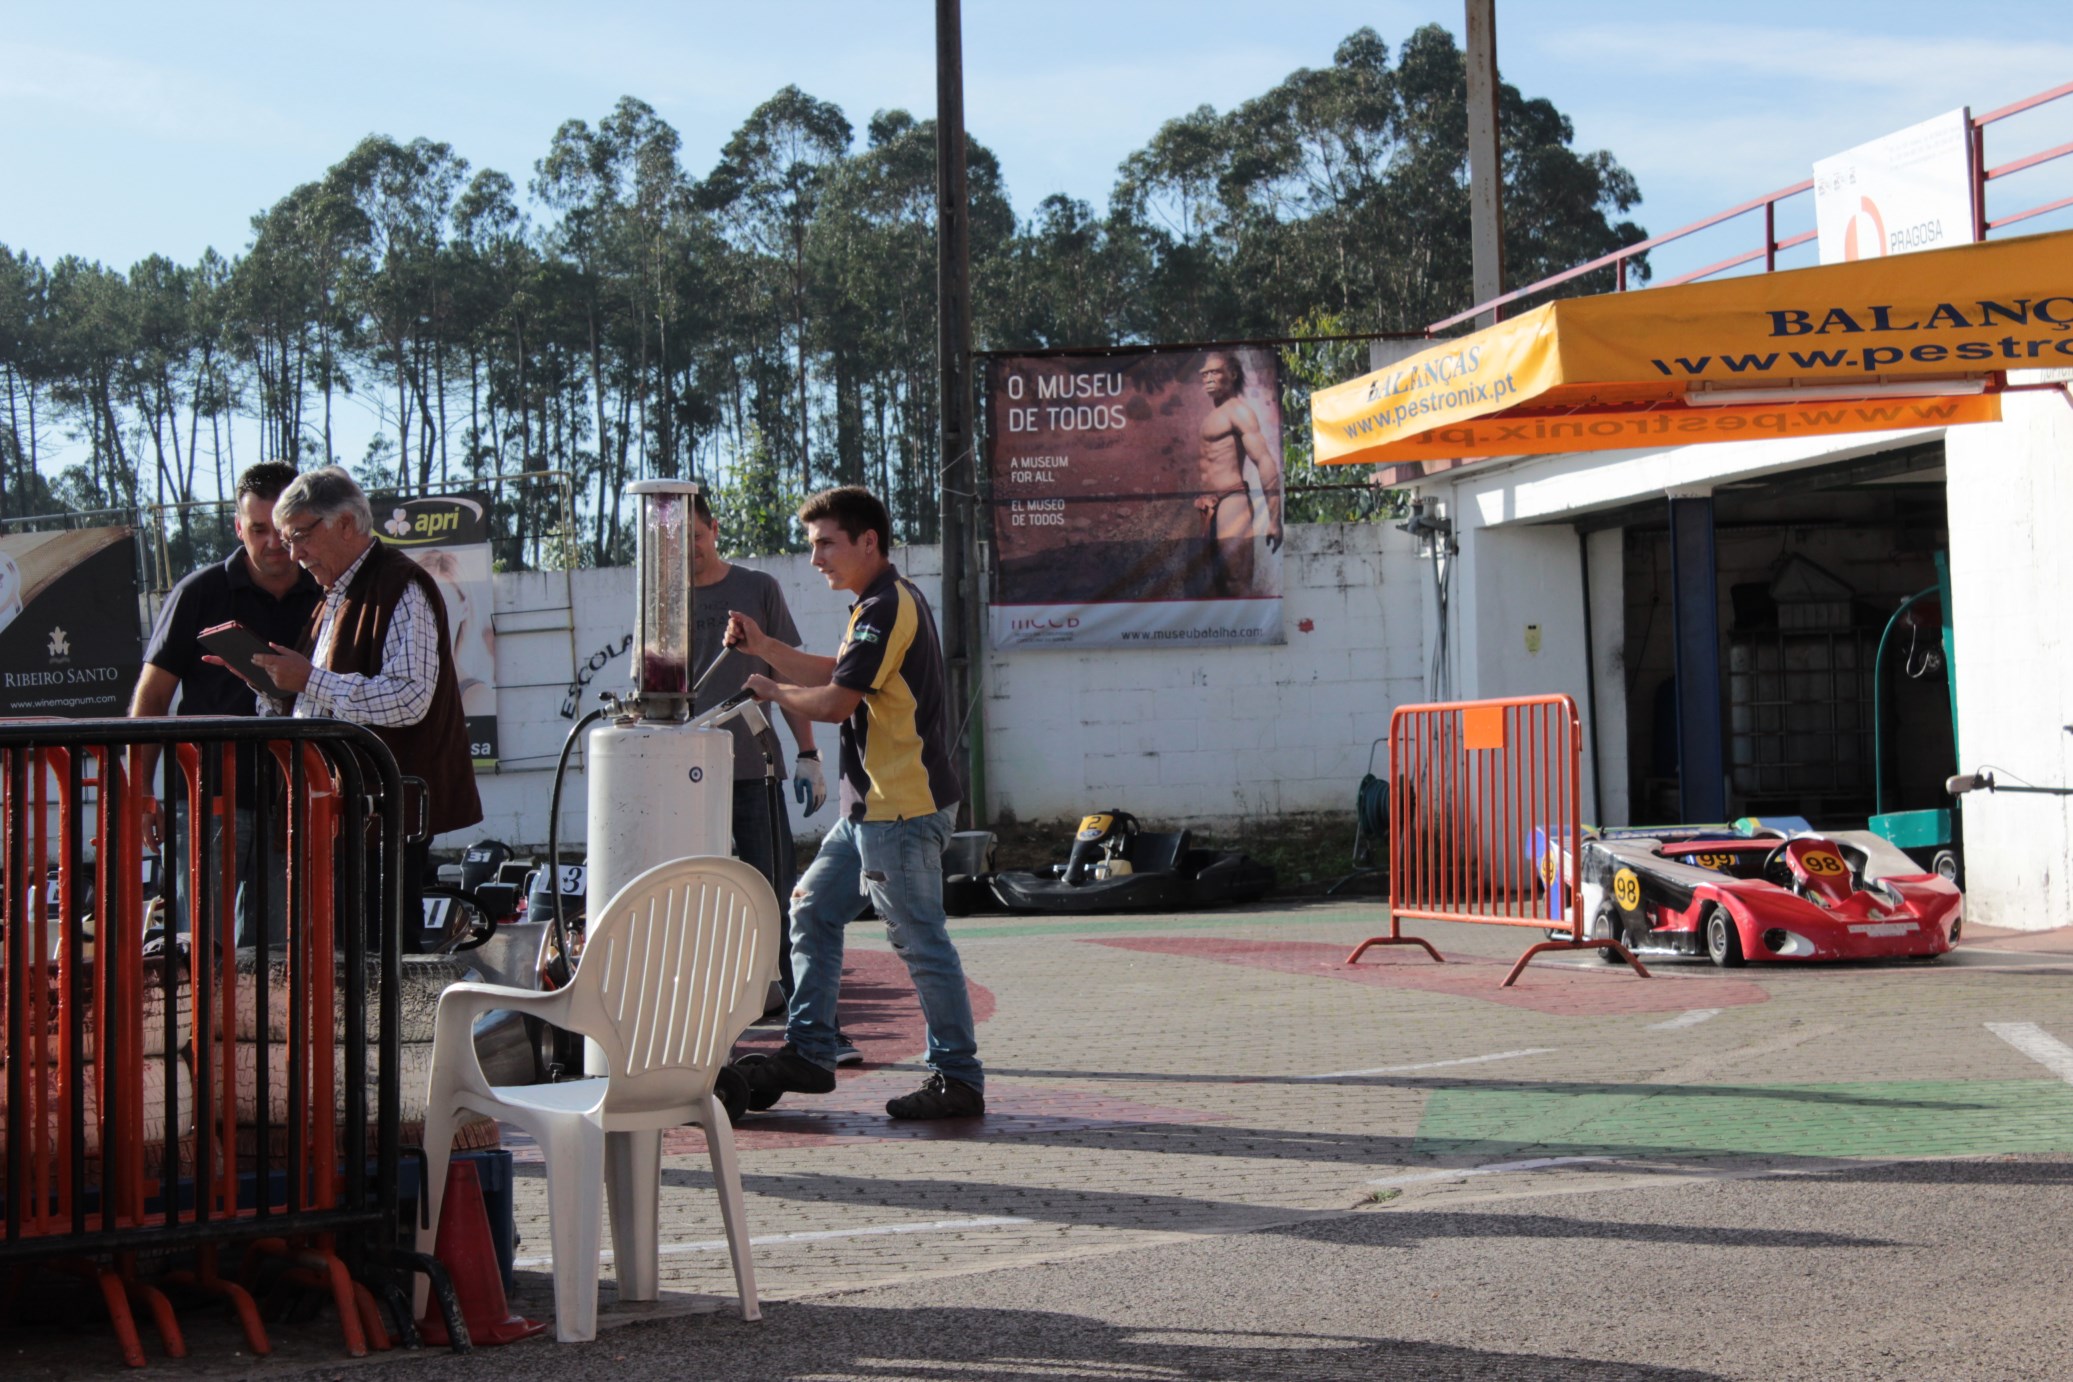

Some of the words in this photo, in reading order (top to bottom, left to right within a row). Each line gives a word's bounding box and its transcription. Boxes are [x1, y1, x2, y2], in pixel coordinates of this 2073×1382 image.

[1890, 219, 1944, 252] PRAGOSA
[1367, 346, 1481, 403] BALANÇAS
[1008, 375, 1024, 400] O
[1038, 372, 1122, 399] MUSEU
[1343, 372, 1517, 439] www.pestronix.pt
[1009, 407, 1039, 432] DE
[1046, 404, 1126, 431] TODOS
[1010, 456, 1019, 469] A
[1020, 455, 1069, 469] MUSEUM
[1011, 470, 1033, 483] FOR
[1035, 470, 1056, 483] ALL
[1011, 499, 1025, 512] EL
[1027, 498, 1066, 511] MUSEO
[415, 506, 460, 537] apri
[1012, 513, 1026, 526] DE
[1028, 512, 1065, 526] TODOS
[4, 671, 64, 688] RIBEIRO
[67, 666, 119, 684] SANTO
[560, 633, 634, 720] ESCOLA
[10, 694, 116, 710] www.winemagnum.com
[1087, 815, 1102, 830] 2
[467, 851, 492, 863] 31
[1806, 856, 1842, 872] 98
[1617, 877, 1637, 904] 98
